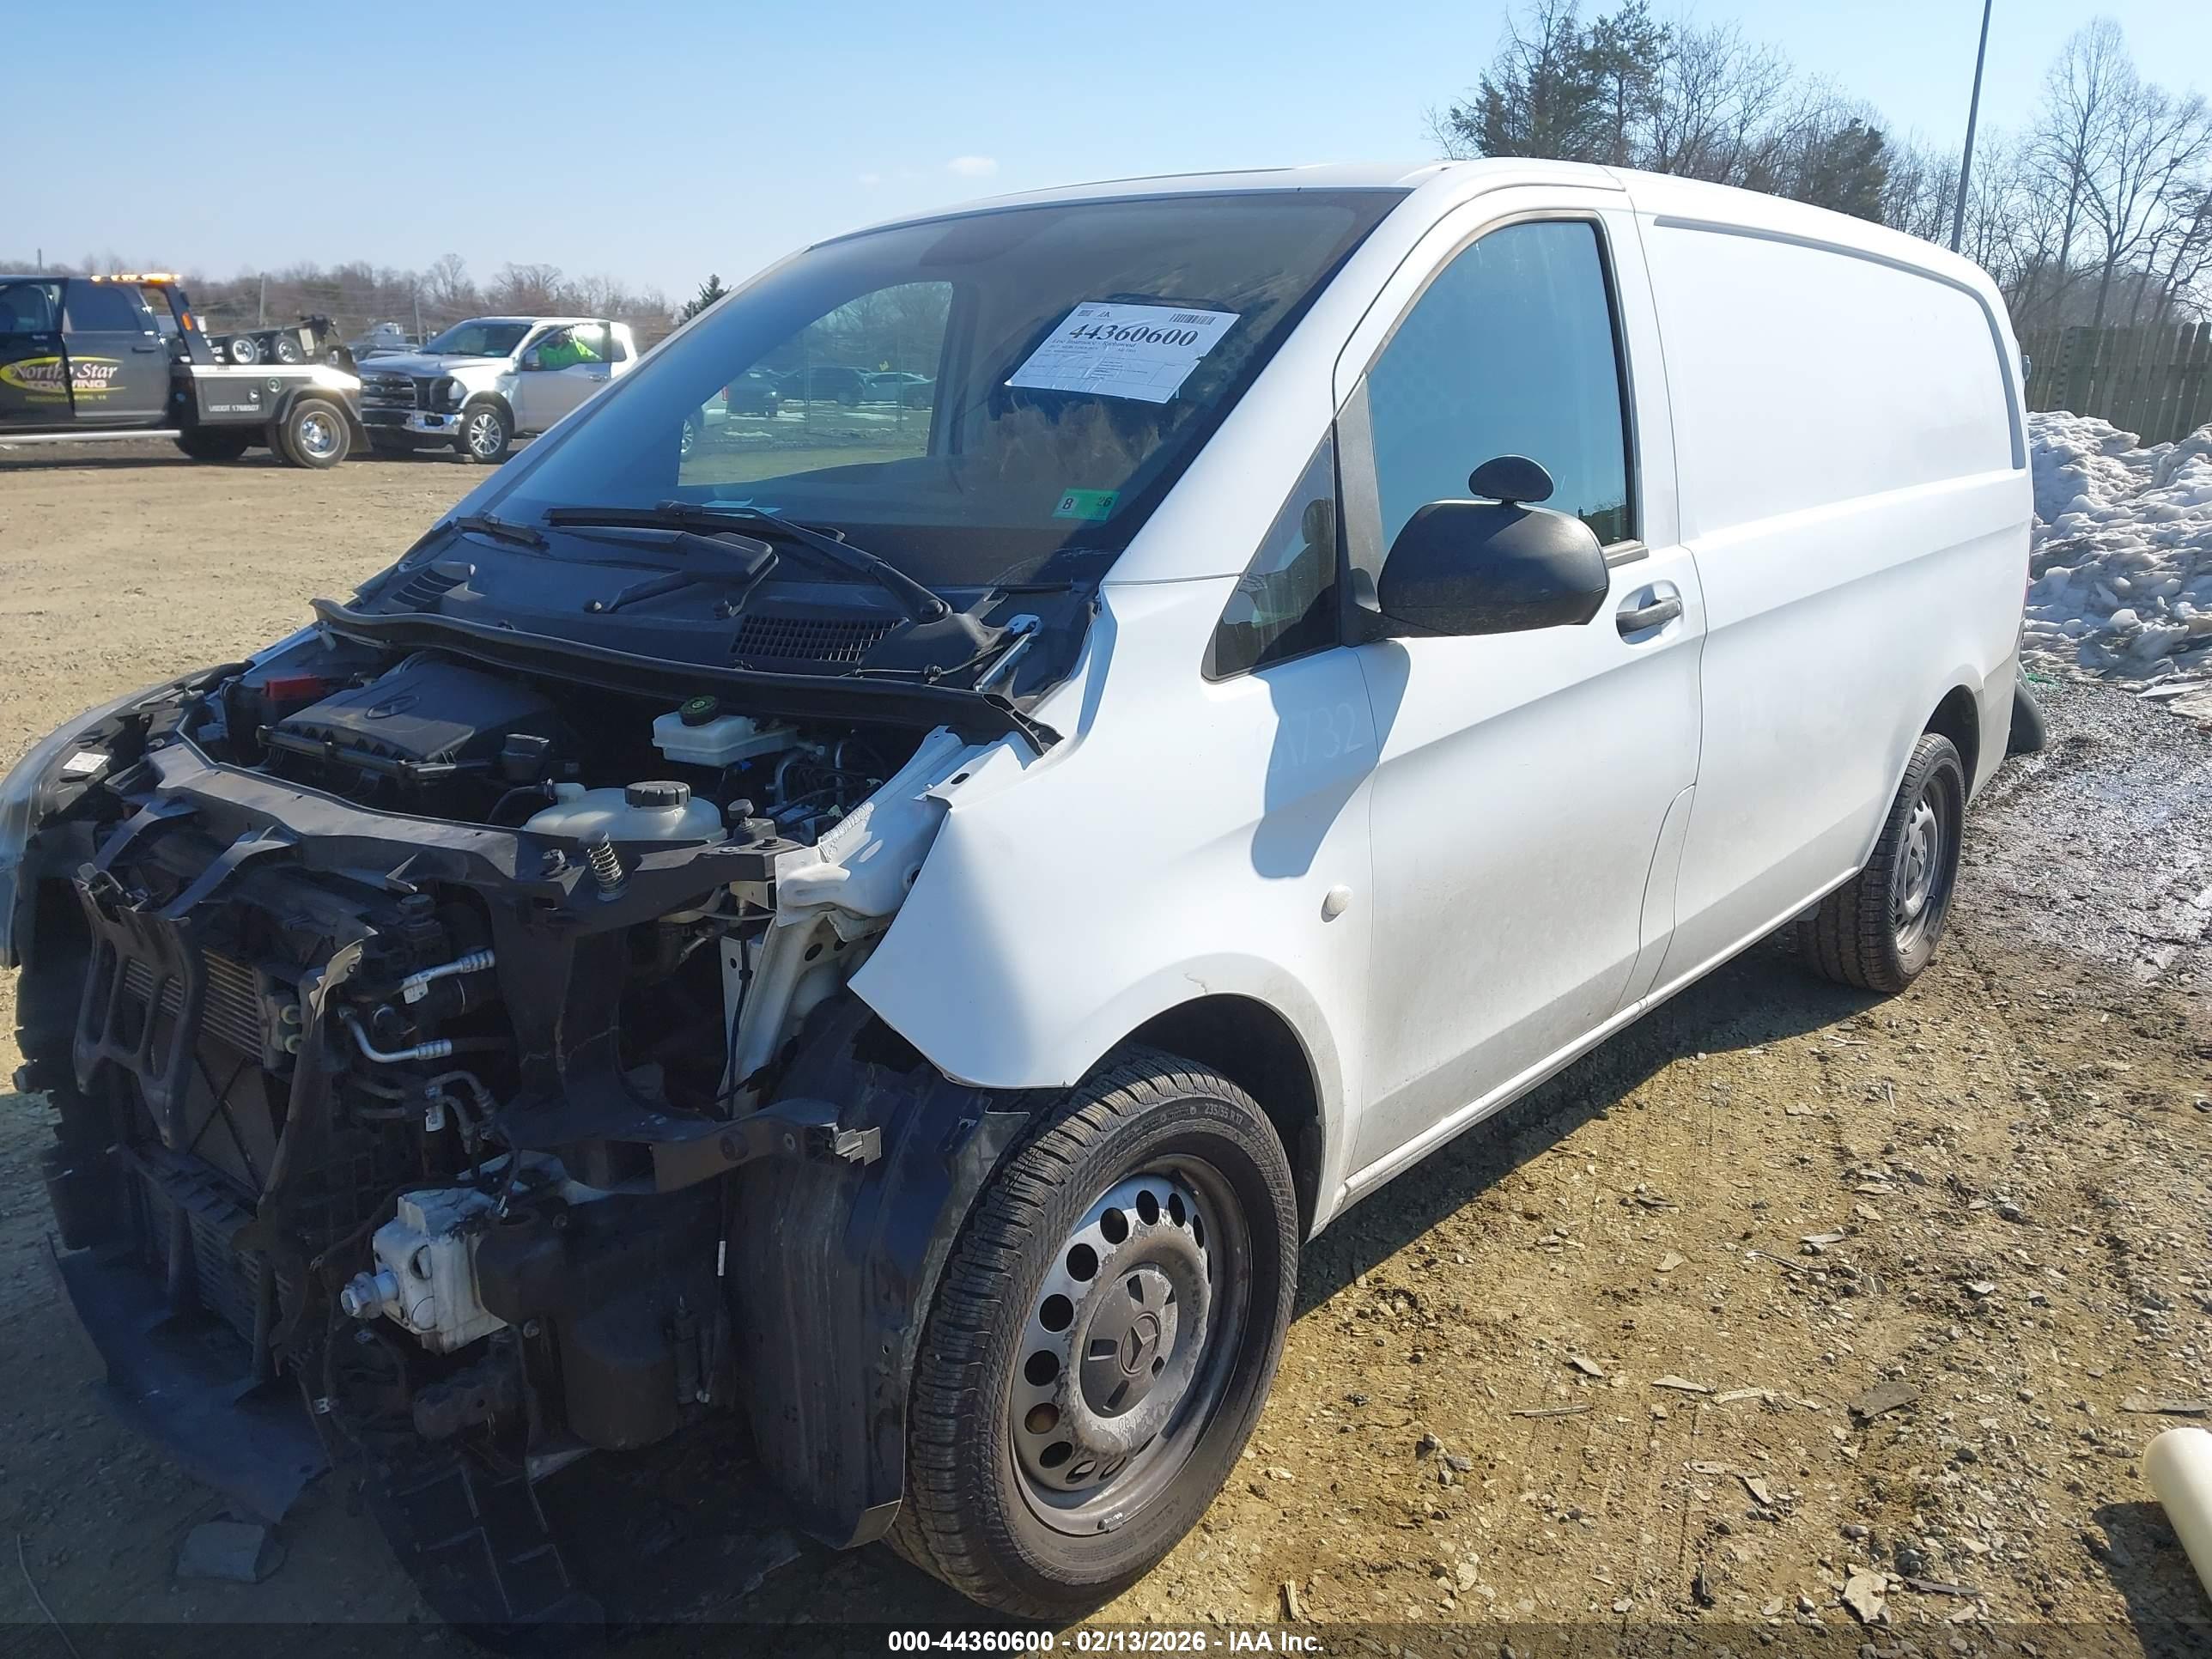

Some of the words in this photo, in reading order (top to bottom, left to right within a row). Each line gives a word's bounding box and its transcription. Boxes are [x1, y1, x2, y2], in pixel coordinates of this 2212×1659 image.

[1069, 324, 1199, 346] 44360600
[76, 362, 118, 379] Star
[1062, 497, 1073, 510] 8
[1204, 1103, 1230, 1119] 235/55
[1230, 1109, 1237, 1121] R
[1237, 1113, 1244, 1125] 17
